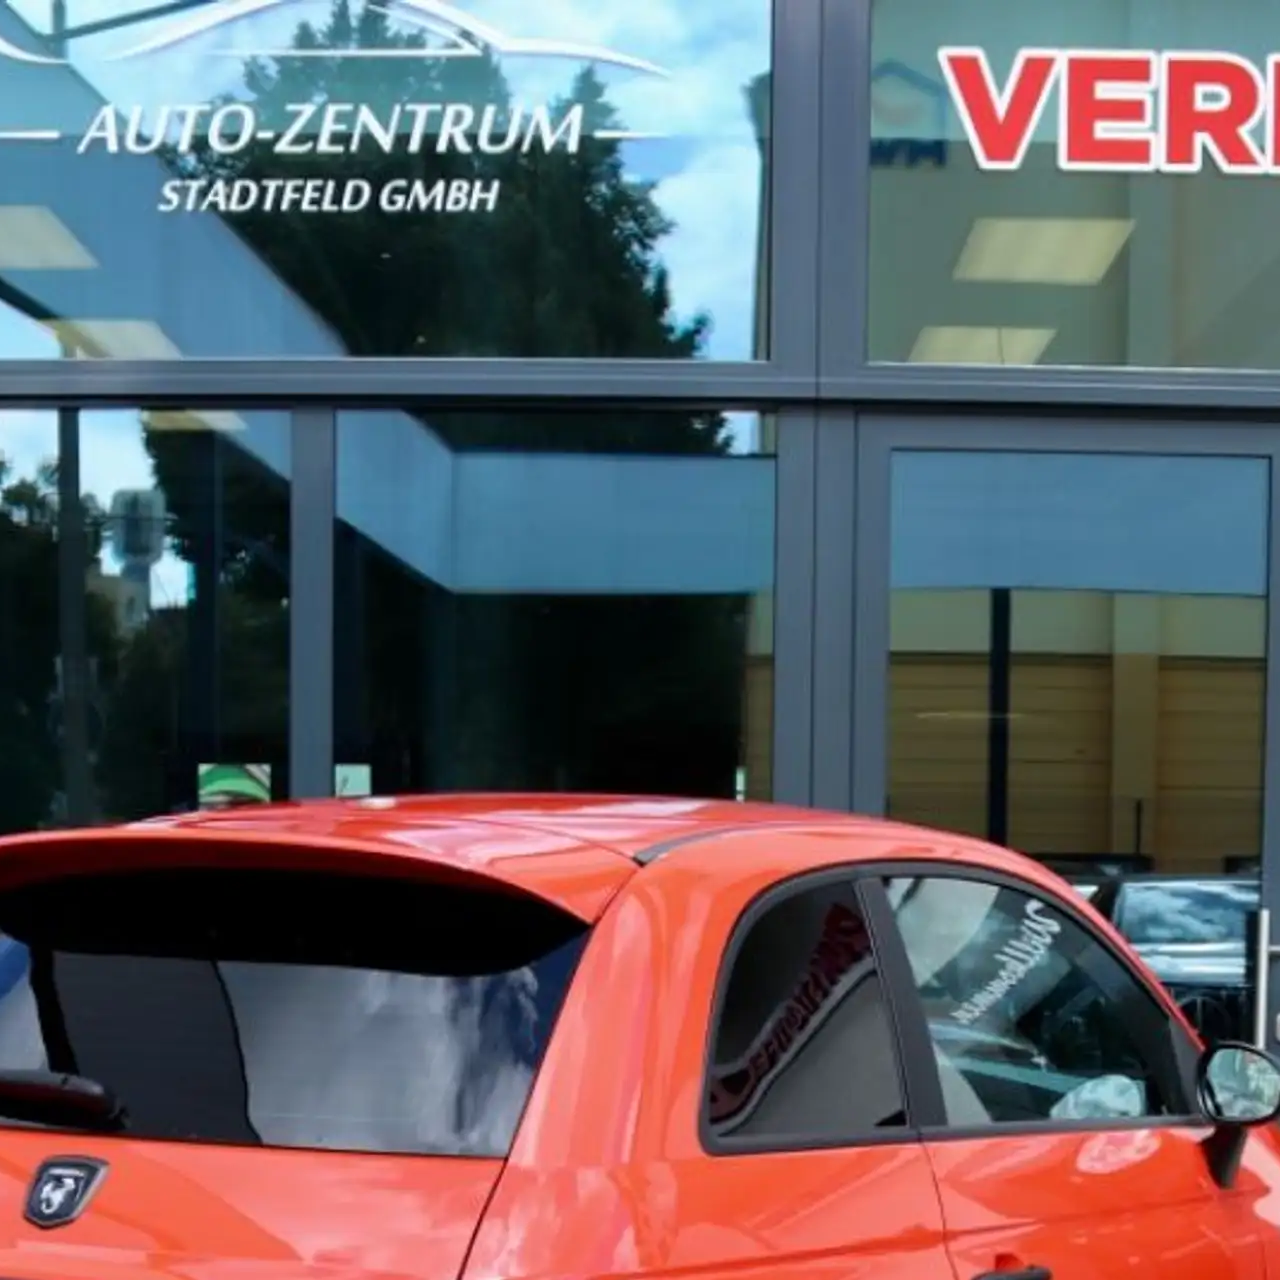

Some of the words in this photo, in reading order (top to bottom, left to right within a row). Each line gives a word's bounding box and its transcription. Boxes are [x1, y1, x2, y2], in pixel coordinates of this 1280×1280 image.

[77, 103, 582, 155] AUTO-ZENTRUM
[157, 177, 372, 214] STADTFELD
[379, 178, 500, 214] GMBH
